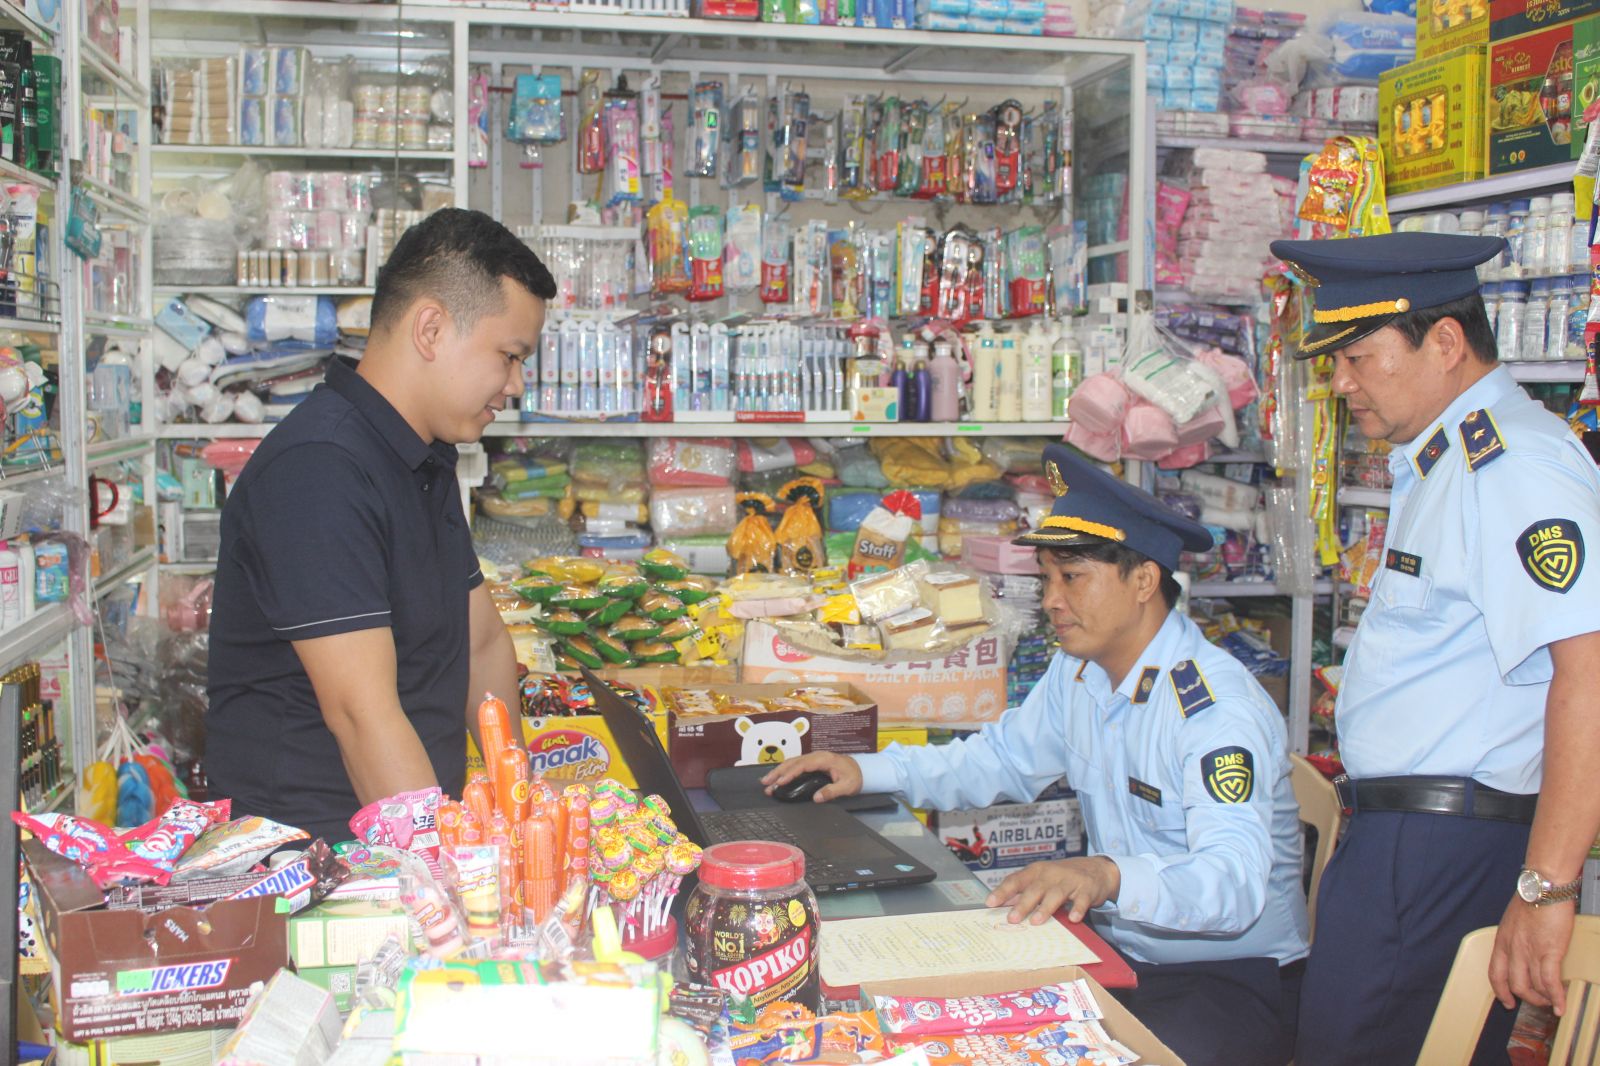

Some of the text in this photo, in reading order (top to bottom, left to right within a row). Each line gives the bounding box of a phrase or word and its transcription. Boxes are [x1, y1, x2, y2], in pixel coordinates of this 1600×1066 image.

[1528, 525, 1562, 547] DMS
[860, 540, 896, 559] Staff
[527, 736, 598, 771] naak
[1214, 753, 1245, 768] DMS
[988, 824, 1064, 844] AIRBLADE
[714, 931, 744, 939] WORLD'S
[713, 938, 745, 953] No.1
[715, 937, 806, 998] KOPIKO
